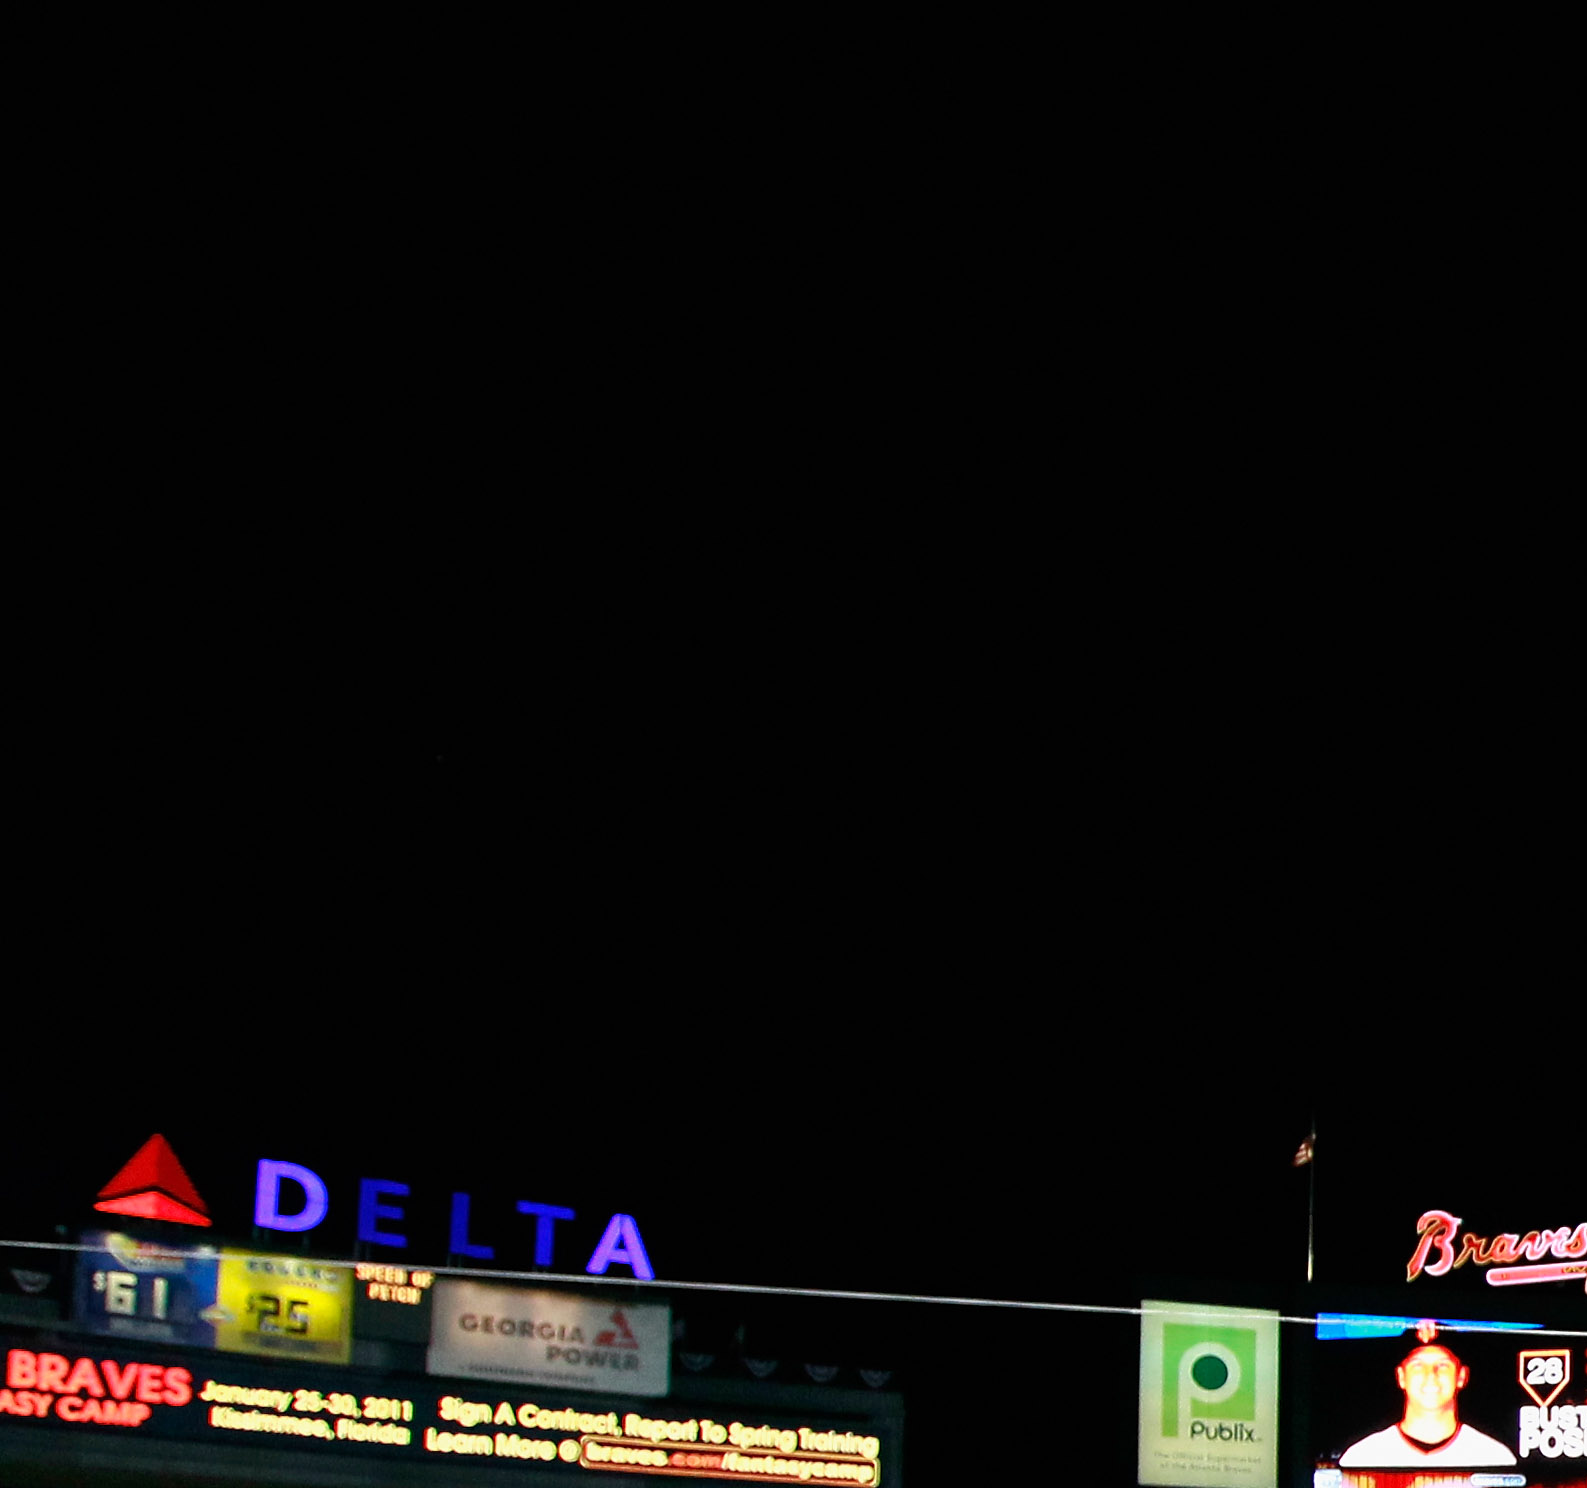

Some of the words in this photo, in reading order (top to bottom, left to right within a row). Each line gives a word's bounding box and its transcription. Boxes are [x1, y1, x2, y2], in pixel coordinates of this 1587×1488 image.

[254, 1158, 655, 1281] DELTA
[355, 1262, 407, 1286] SPEED
[367, 1281, 422, 1306] PITCH
[459, 1314, 586, 1345] GEORGIA
[545, 1346, 639, 1371] POWER
[1526, 1357, 1564, 1385] 28
[6, 1349, 193, 1406] BRAVES
[56, 1397, 152, 1427] CAMP
[201, 1380, 293, 1412] January
[363, 1397, 414, 1421] 2011
[336, 1419, 411, 1446] Florida
[438, 1396, 493, 1427] Sign
[496, 1402, 516, 1426] A
[517, 1404, 622, 1437] Contract,
[623, 1415, 699, 1442] Report
[700, 1420, 727, 1443] To
[728, 1422, 797, 1453] Spring
[799, 1428, 880, 1458] Training
[1190, 1421, 1256, 1443] Publix
[424, 1428, 493, 1456] Learn
[496, 1433, 556, 1460] More
